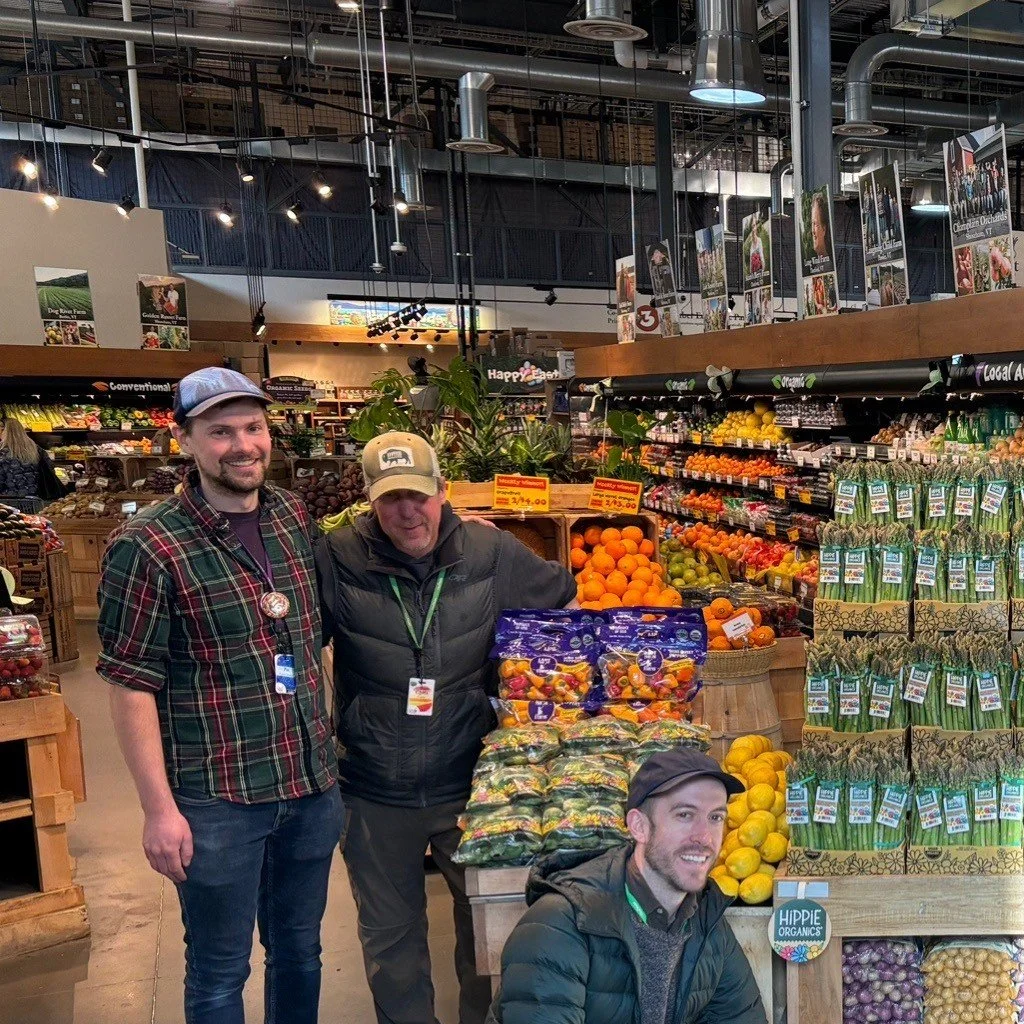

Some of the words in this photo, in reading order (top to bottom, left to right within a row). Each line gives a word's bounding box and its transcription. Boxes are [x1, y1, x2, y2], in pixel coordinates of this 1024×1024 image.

[639, 310, 655, 327] 3
[487, 369, 526, 383] Happy
[983, 363, 1011, 382] Local
[109, 381, 171, 392] Conventional
[779, 909, 822, 926] HIPPIE
[778, 926, 822, 937] ORGANICS
